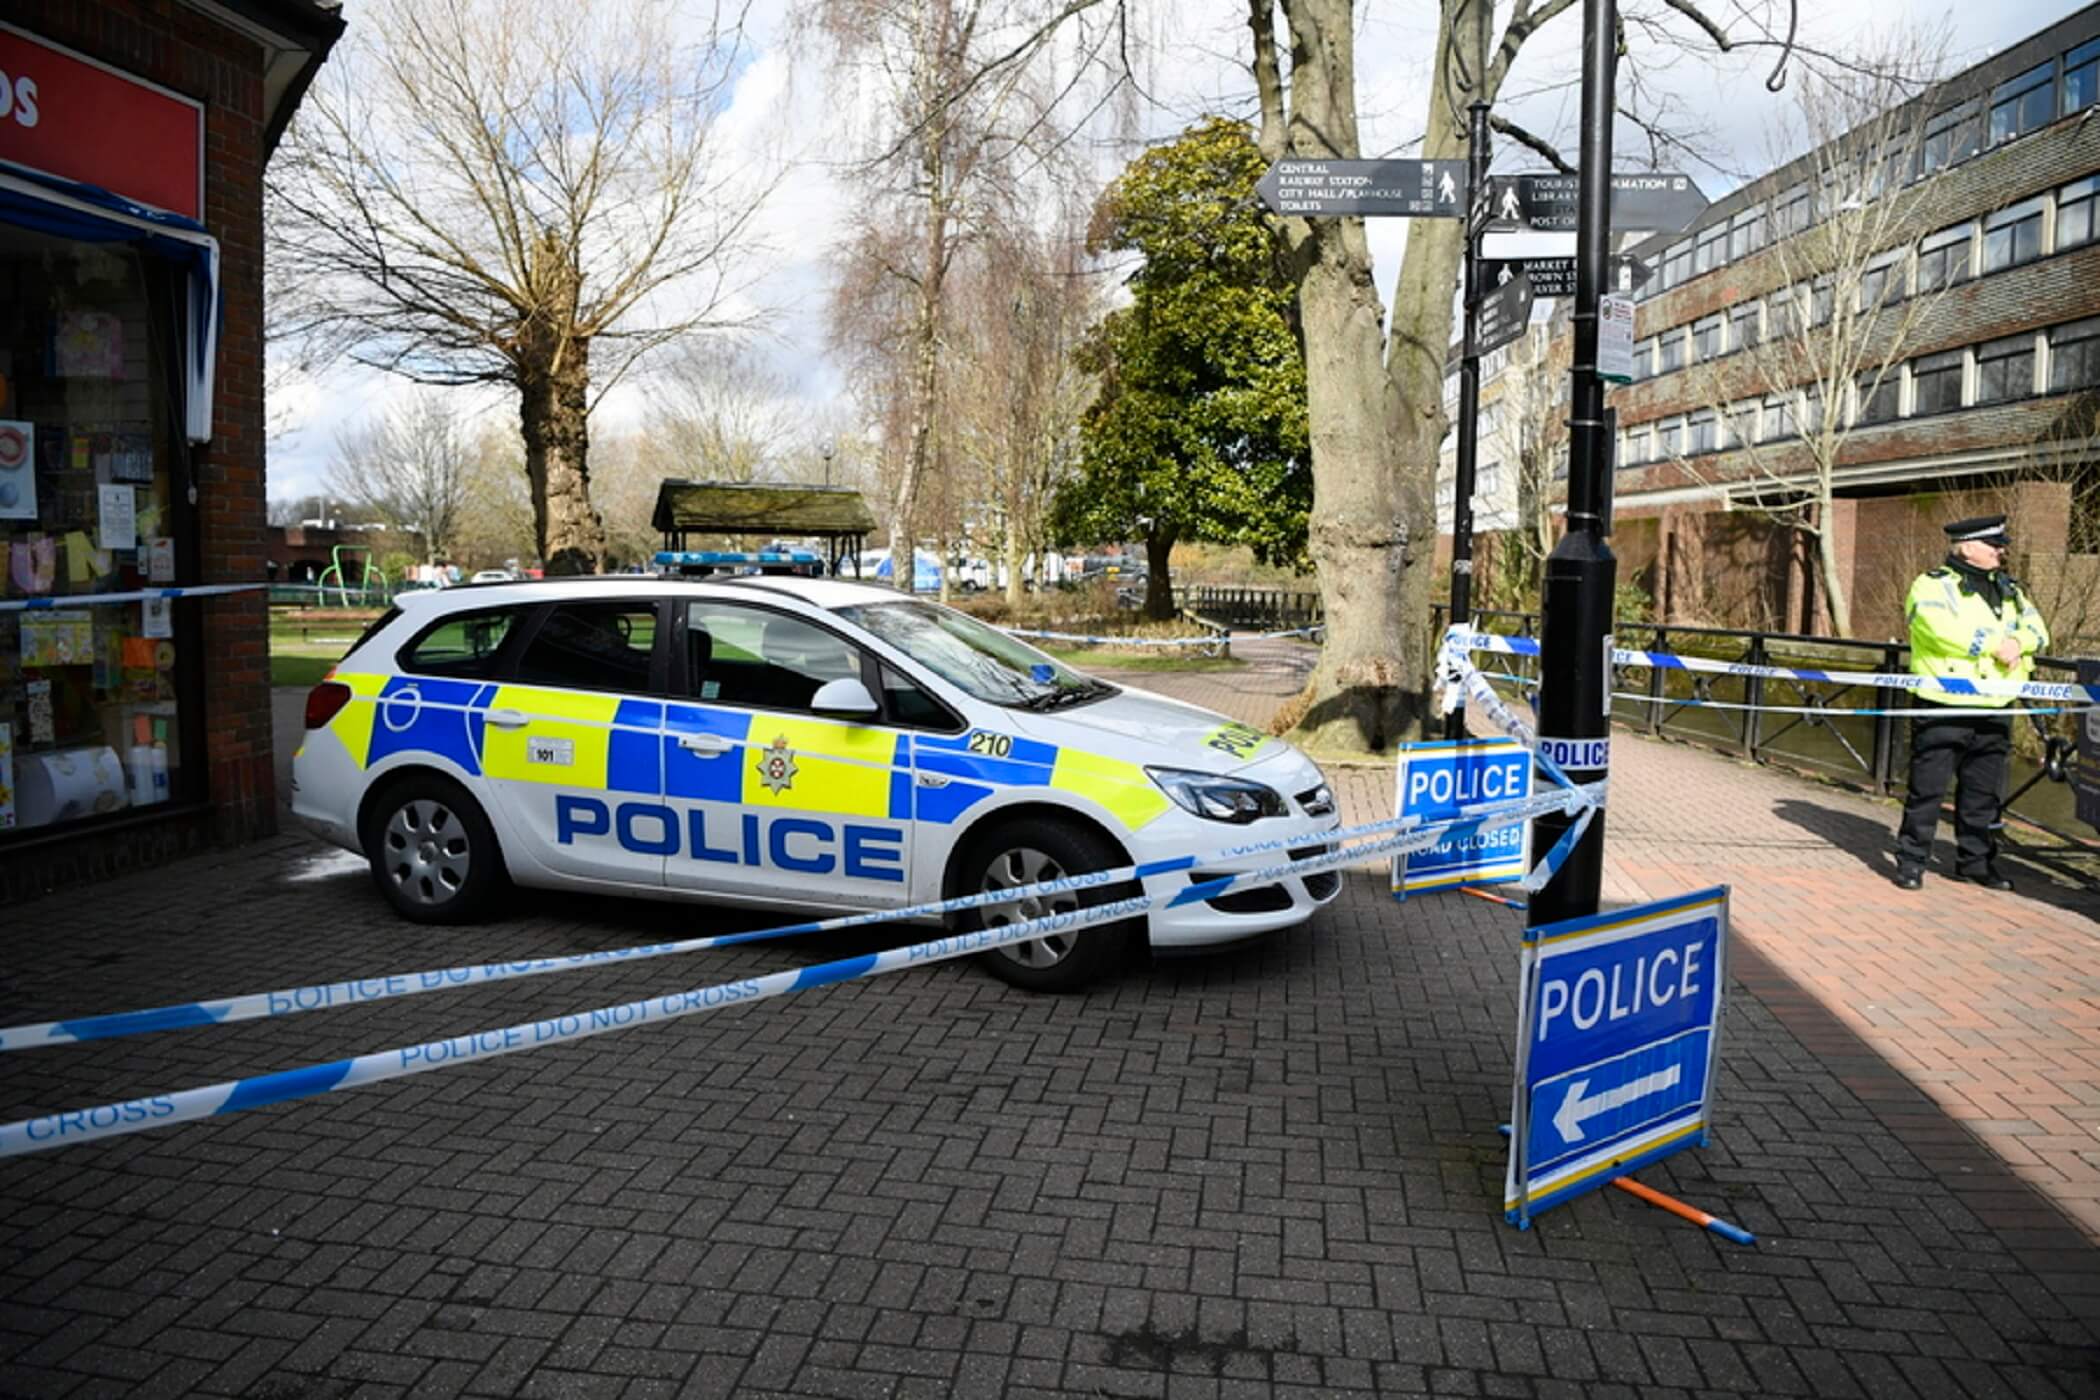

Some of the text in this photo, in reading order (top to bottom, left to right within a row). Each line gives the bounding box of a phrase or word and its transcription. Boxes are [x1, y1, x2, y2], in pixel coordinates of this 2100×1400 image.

[1279, 163, 1329, 173] CENTRAL
[1278, 188, 1304, 198] CITY
[1532, 191, 1579, 202] LIBRARY
[1279, 201, 1321, 211] TOILETS
[1530, 216, 1558, 227] POST
[1874, 675, 1922, 687] POLICE
[2021, 683, 2072, 699] POLICE
[970, 732, 1012, 757] 210
[536, 749, 554, 762] 101
[1409, 764, 1522, 805] POLICE
[555, 794, 905, 883] POLICE
[909, 932, 992, 962] POLICE
[1000, 921, 1030, 942] DO
[1538, 942, 1705, 1042] POLICE
[401, 977, 760, 1068] POLICE DO NOT CROSS
[26, 1094, 176, 1141] CROSS
